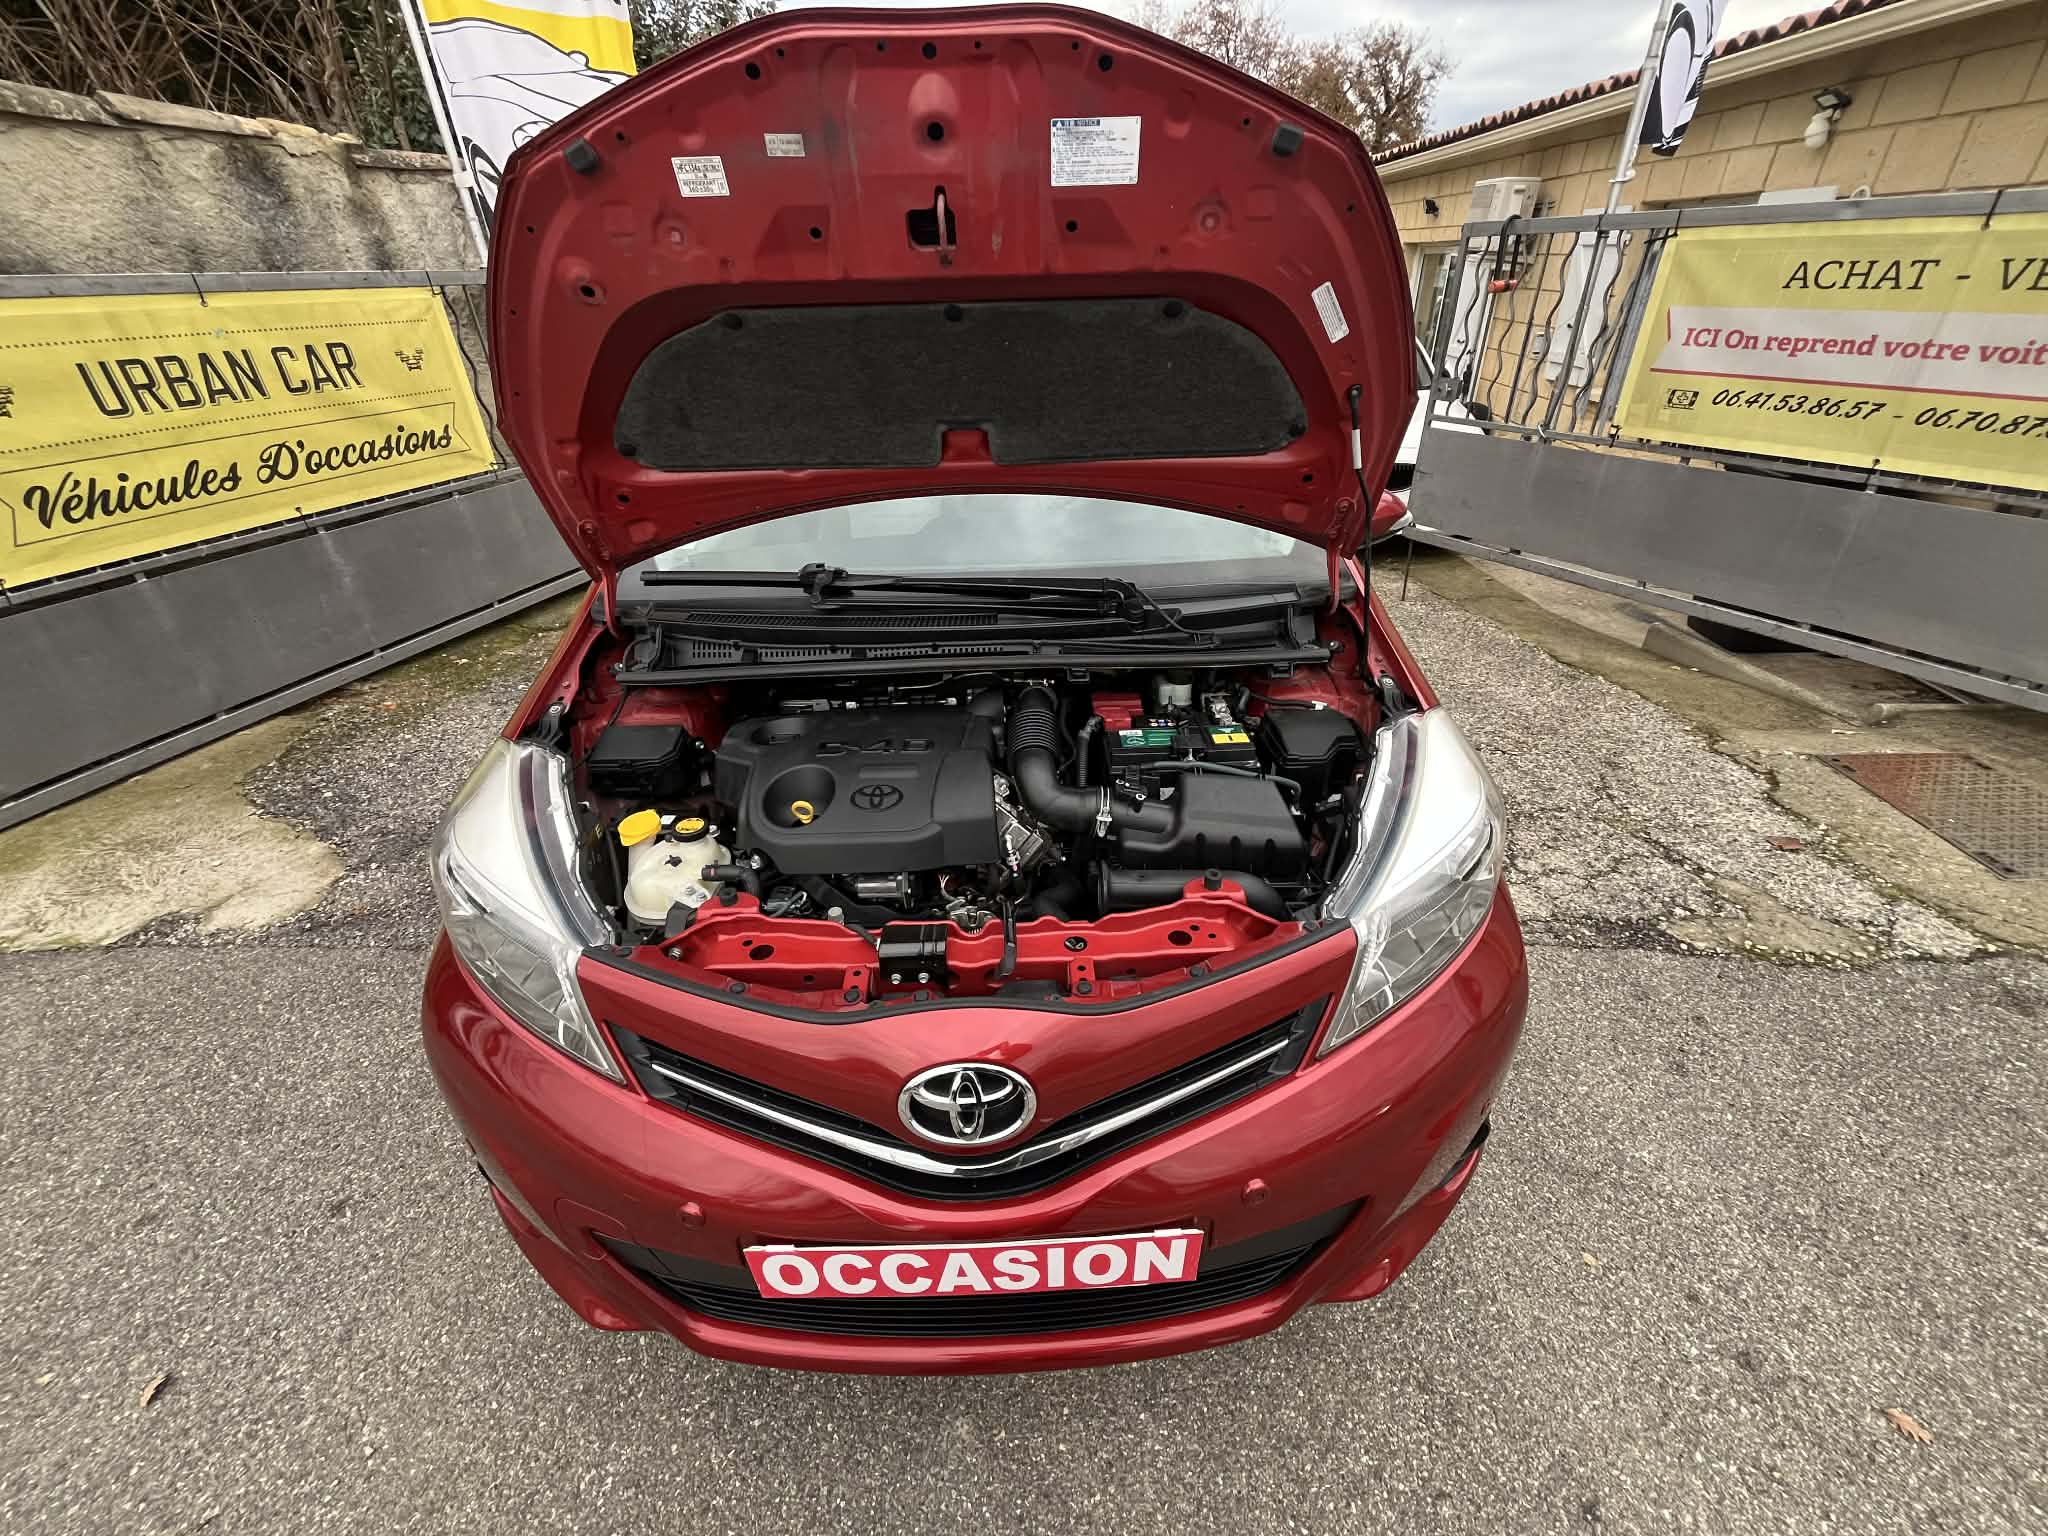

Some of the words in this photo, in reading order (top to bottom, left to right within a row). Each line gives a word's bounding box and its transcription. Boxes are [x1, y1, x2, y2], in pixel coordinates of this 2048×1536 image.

[1782, 259, 1940, 290] ACHAT
[1682, 327, 1723, 348] ICI
[1726, 330, 1759, 349] On
[1764, 334, 1878, 357] reprend
[1883, 338, 1970, 361] votre
[75, 347, 272, 418] URBAN
[270, 341, 365, 395] CAR
[1711, 388, 1887, 421] 06.41.53.86.57
[1914, 406, 2048, 439] 06.70.87.
[23, 459, 243, 529] Véhicules
[256, 424, 453, 485] D'occasions
[761, 1239, 1188, 1294] OCCASION
